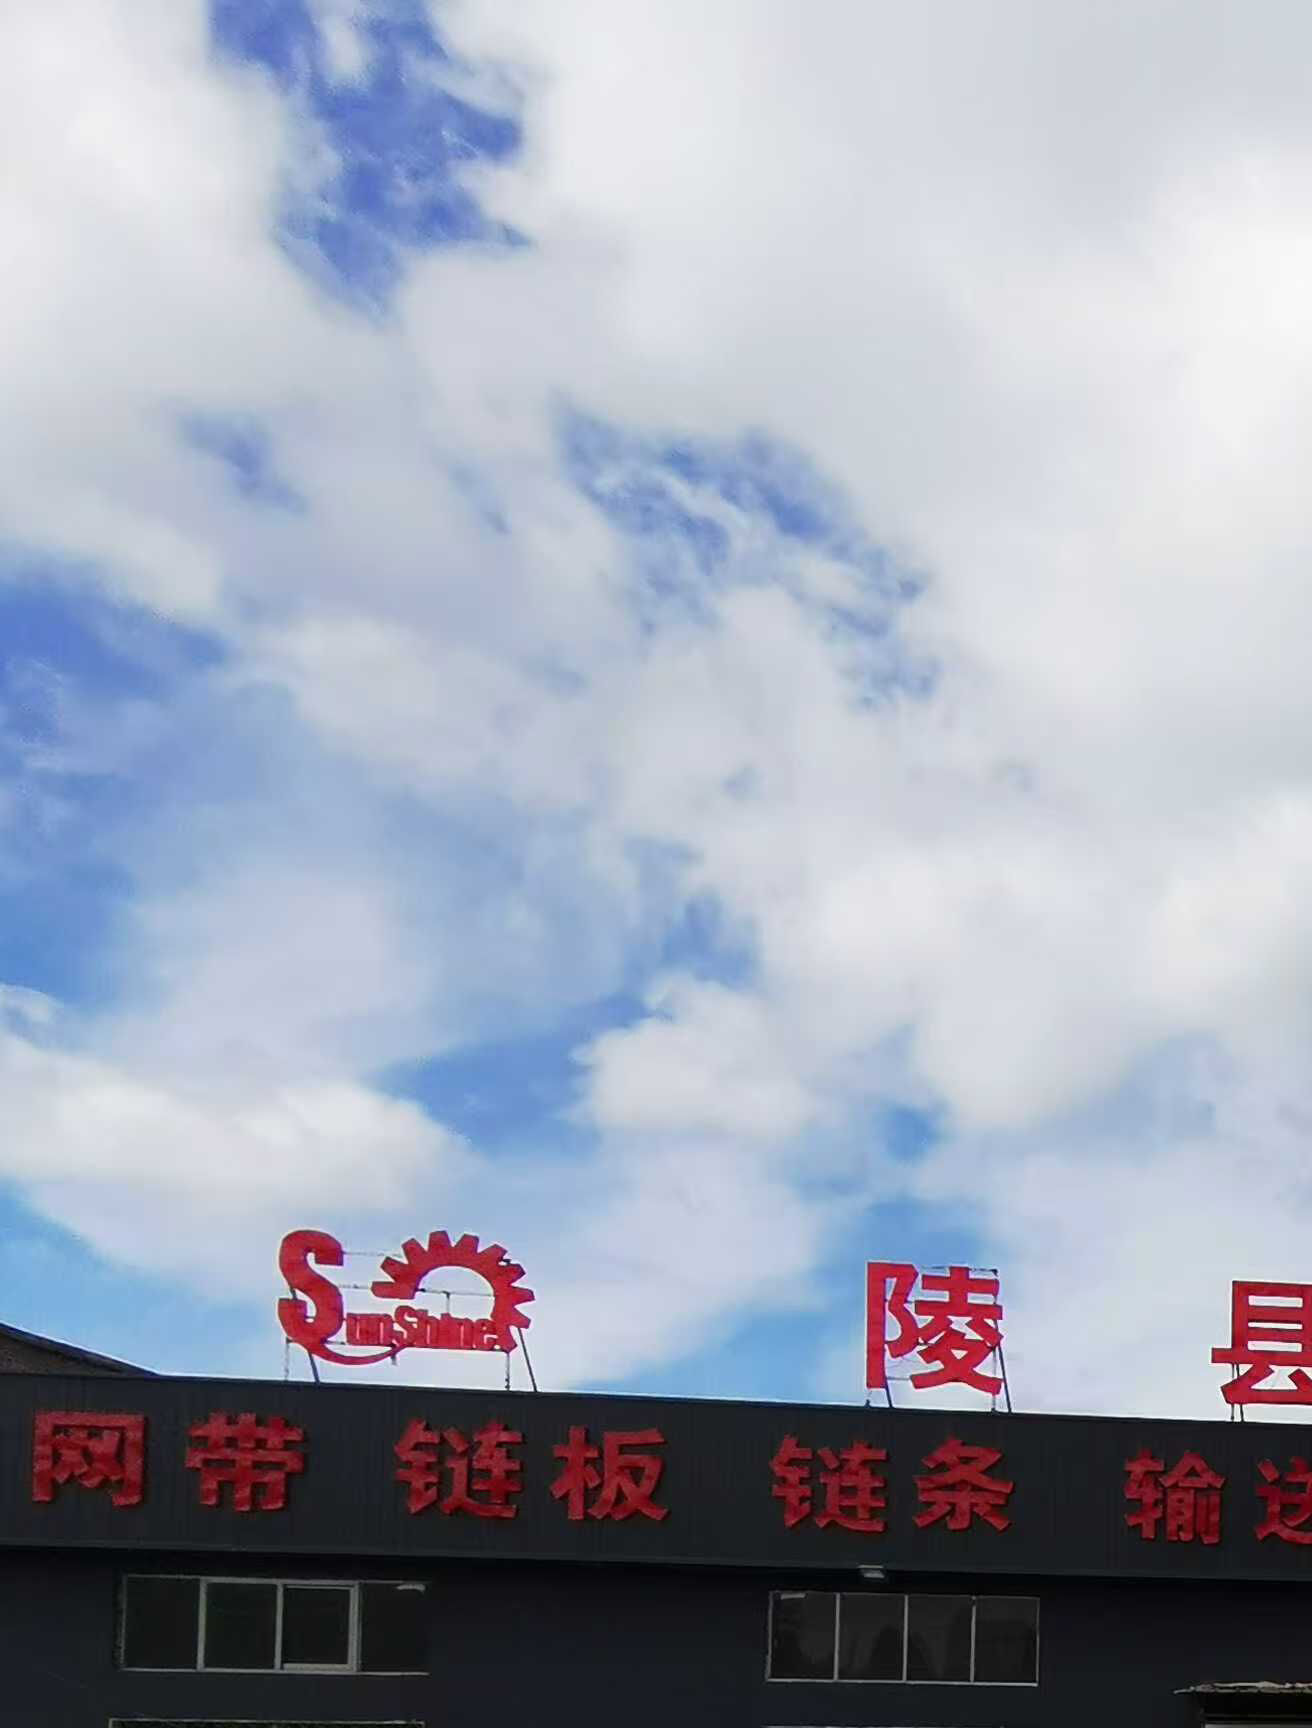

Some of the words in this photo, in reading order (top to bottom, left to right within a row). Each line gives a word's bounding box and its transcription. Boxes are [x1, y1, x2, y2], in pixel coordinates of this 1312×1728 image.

[32, 1411, 307, 1511] 网带
[394, 1418, 670, 1522] 链板
[770, 1433, 1016, 1535] 链条
